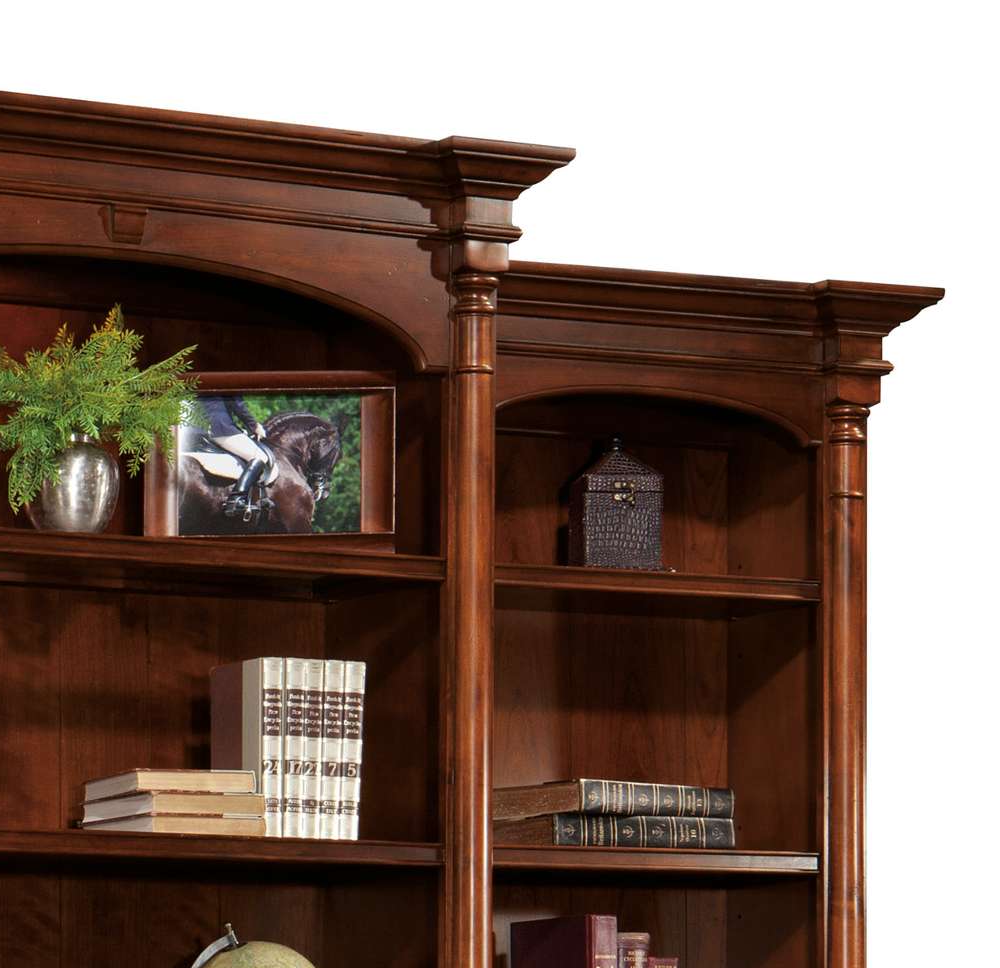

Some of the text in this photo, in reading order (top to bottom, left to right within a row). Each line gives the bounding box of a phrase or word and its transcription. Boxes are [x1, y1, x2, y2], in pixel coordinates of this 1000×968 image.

[289, 761, 302, 774] 17
[328, 763, 337, 776] 7
[347, 763, 356, 776] 5
